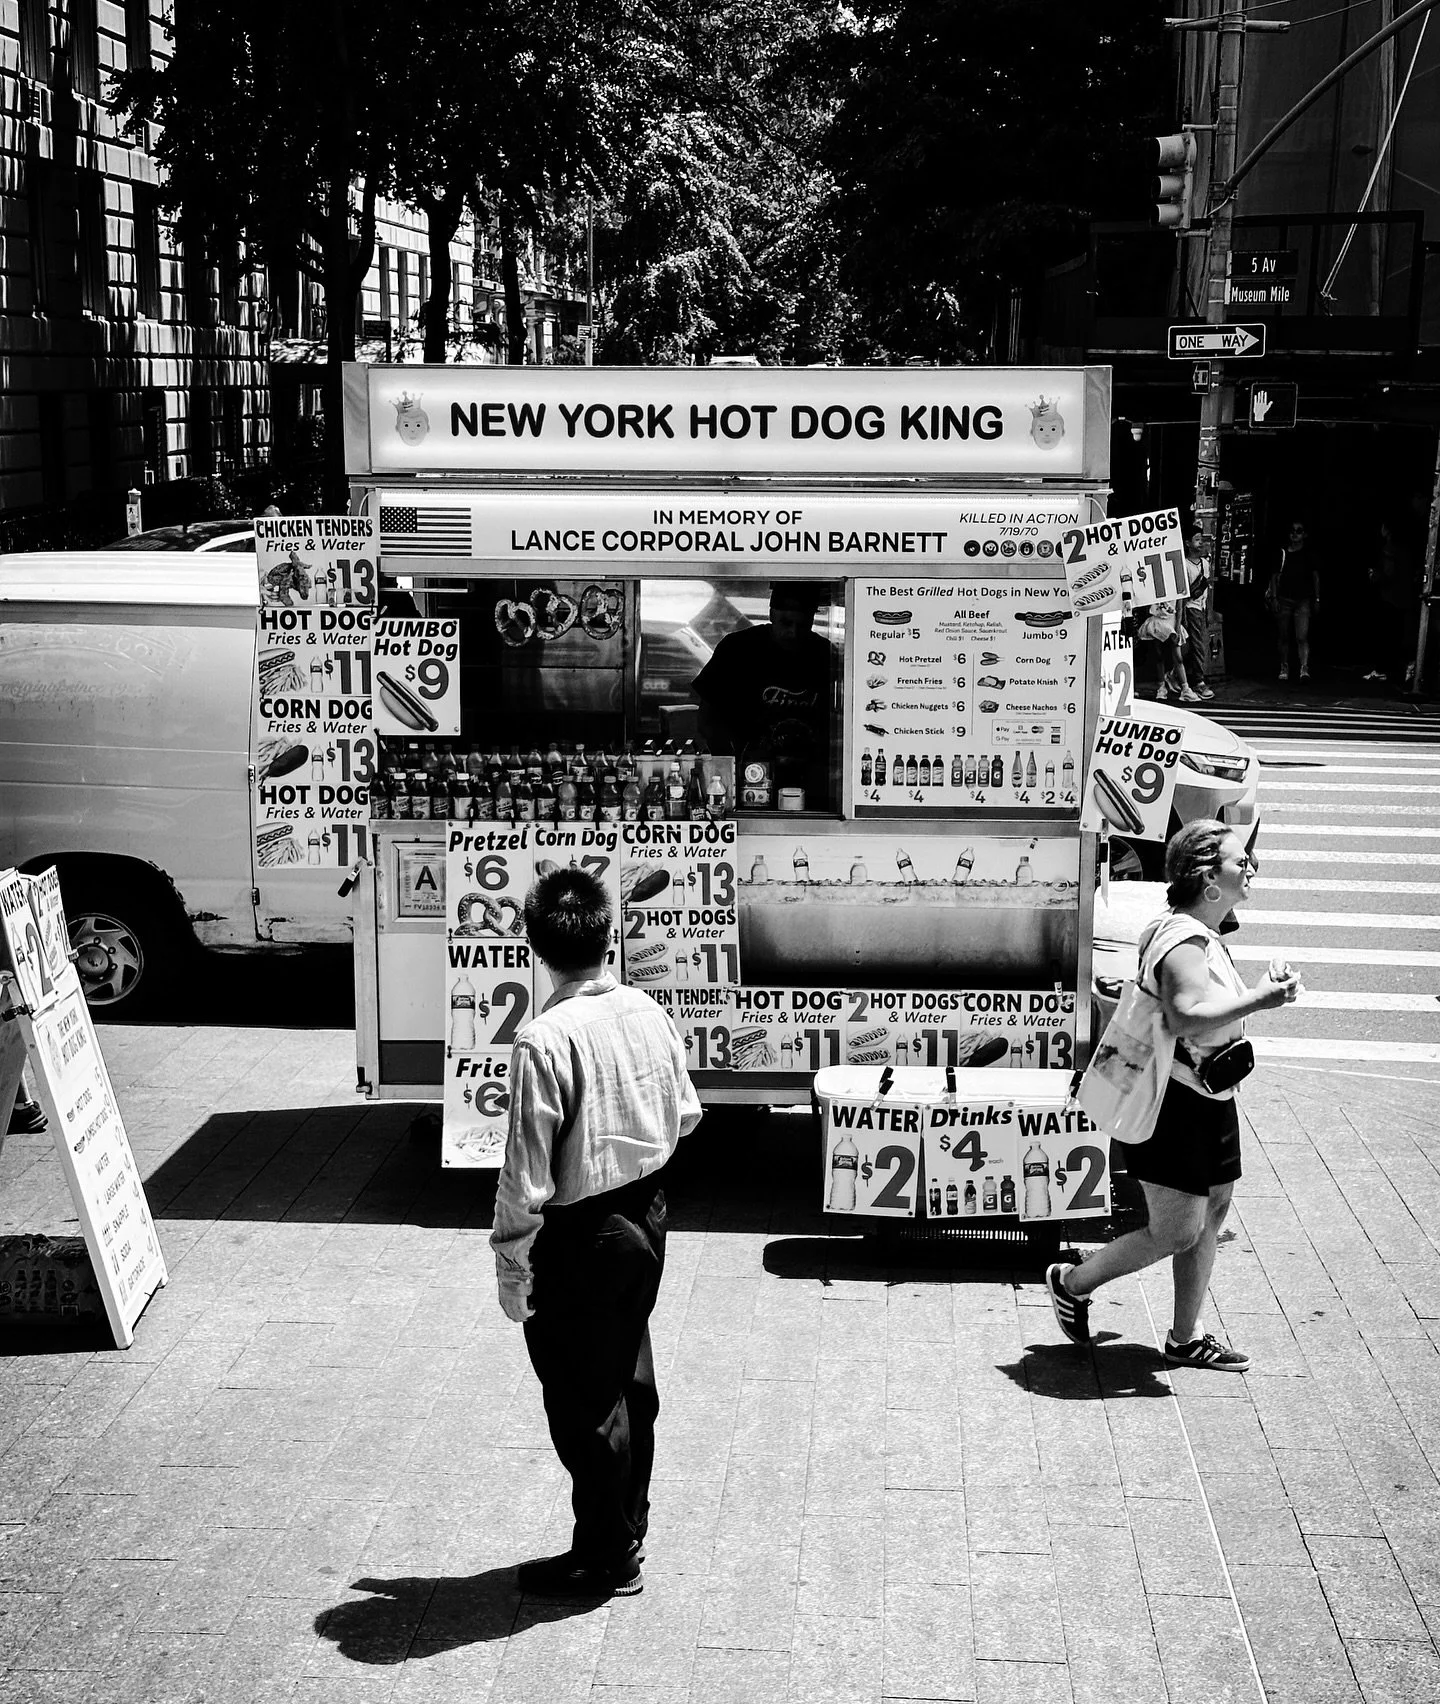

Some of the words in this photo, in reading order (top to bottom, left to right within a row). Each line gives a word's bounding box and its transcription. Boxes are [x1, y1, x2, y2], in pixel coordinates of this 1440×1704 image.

[1252, 258, 1258, 272] 5
[1262, 258, 1276, 272] Av
[1232, 286, 1266, 302] Museum
[1270, 286, 1290, 302] Mile
[1179, 336, 1204, 348] ONE
[1222, 335, 1248, 348] WAY
[451, 402, 546, 438] NEW
[558, 403, 674, 438] YORK
[690, 404, 778, 440] HOT
[791, 405, 885, 440] DOG
[900, 405, 1003, 440] KING
[654, 510, 675, 525] IN
[679, 510, 770, 525] MEMORY
[776, 510, 803, 525] OF
[959, 512, 1006, 524] KILLED
[1008, 513, 1024, 524] IN
[1026, 513, 1079, 525] ACTION
[256, 520, 313, 538] CHICKEN
[316, 519, 373, 538] TENDERS
[998, 526, 1038, 537] 7/19/70
[1064, 529, 1087, 564] 2
[1085, 522, 1123, 546] HOT
[1128, 512, 1179, 536] DOGS
[266, 539, 300, 552] Fries
[304, 539, 316, 550] &
[322, 538, 366, 551] Water
[512, 530, 596, 551] LANCE
[602, 530, 744, 552] CORPORAL
[750, 532, 820, 552] JOHN
[828, 532, 948, 553] BARNETT
[1108, 543, 1118, 556] &
[1124, 535, 1168, 552] Water
[327, 558, 376, 604] $13
[1136, 550, 1188, 598] $11
[866, 586, 886, 596] The
[889, 586, 914, 597] Best
[916, 586, 954, 598] Grilled
[957, 587, 978, 597] Hot
[980, 587, 1008, 600] Dogs
[1010, 587, 1022, 598] in
[1024, 588, 1050, 598] New
[260, 610, 312, 630] HOT
[320, 610, 371, 630] DOG
[954, 610, 967, 620] All
[968, 610, 990, 620] Beef
[267, 632, 301, 645] Fries
[306, 632, 317, 645] &
[322, 632, 368, 645] Water
[375, 620, 458, 638] JUMBO
[870, 630, 906, 642] Regular
[908, 628, 920, 640] $5
[1022, 631, 1054, 640] Jumbo
[1055, 629, 1068, 640] $9
[374, 638, 412, 656] Hot
[418, 640, 458, 662] Dog
[1104, 630, 1132, 651] ATER
[916, 656, 942, 664] Pretzel
[953, 654, 966, 664] $6
[1016, 656, 1034, 664] Corn
[1035, 656, 1052, 666] Dog
[1064, 654, 1076, 666] $7
[324, 650, 372, 694] $11
[404, 658, 450, 700] $9
[952, 676, 966, 688] $6
[1009, 678, 1036, 686] Potato
[1036, 678, 1058, 686] Knish
[1064, 676, 1076, 688] $7
[1108, 662, 1132, 716] $2
[260, 698, 320, 718] CORN
[328, 700, 372, 720] DOG
[919, 703, 948, 712] Nuggets
[952, 701, 966, 712] $6
[1063, 702, 1076, 714] $6
[268, 720, 302, 733] Fries
[306, 720, 318, 733] &
[323, 721, 368, 734] Water
[952, 726, 966, 738] $9
[1100, 720, 1182, 745] JUMBO
[326, 738, 376, 783] $13
[1095, 736, 1134, 758] Hot
[1138, 743, 1179, 769] Dog
[1120, 762, 1164, 804] $9
[260, 785, 311, 805] HOT
[318, 785, 370, 806] DOG
[864, 790, 880, 802] $4
[908, 790, 924, 802] $4
[970, 790, 986, 804] $4
[1014, 790, 1030, 804] $4
[1040, 791, 1056, 804] $2
[1059, 790, 1076, 804] $4
[266, 806, 300, 819] Fries
[304, 806, 316, 818] &
[321, 806, 364, 819] Water
[449, 828, 528, 852] Pretzel
[534, 829, 576, 846] Corn
[582, 828, 618, 852] Dog
[622, 824, 682, 844] CORN
[689, 824, 736, 844] DOG
[322, 824, 368, 867] $11
[630, 846, 663, 858] Fries
[668, 846, 678, 858] &
[683, 846, 728, 858] Water
[414, 866, 438, 890] A
[464, 854, 510, 891] $6
[687, 862, 736, 906] $13
[624, 911, 646, 940] 2
[646, 910, 682, 926] HOT
[688, 909, 736, 926] DOGS
[666, 928, 677, 938] &
[682, 928, 725, 938] Water
[448, 946, 530, 968] WATER
[692, 944, 738, 983] $11
[735, 990, 784, 1010] HOT
[792, 990, 842, 1010] DOG
[848, 992, 868, 1022] 2
[870, 992, 906, 1009] HOT
[912, 992, 960, 1010] DOGS
[962, 993, 1022, 1013] CORN
[1029, 994, 1074, 1014] DOG
[478, 982, 530, 1044] $2
[680, 1008, 722, 1019] Water
[741, 1011, 774, 1023] Fries
[778, 1011, 788, 1023] &
[794, 1011, 836, 1024] Water
[888, 1012, 899, 1023] &
[904, 1011, 948, 1024] Water
[970, 1014, 1002, 1026] Fries
[1006, 1014, 1018, 1026] &
[1023, 1014, 1066, 1027] Water
[684, 1026, 732, 1069] $13
[794, 1028, 840, 1070] $11
[912, 1028, 958, 1067] $11
[1026, 1031, 1072, 1070] $13
[456, 1057, 510, 1078] Frie
[832, 1105, 920, 1133] WATER
[930, 1105, 1013, 1128] Drinks
[940, 1130, 988, 1172] $4
[861, 1144, 916, 1210] $2
[1054, 1145, 1106, 1210] $2
